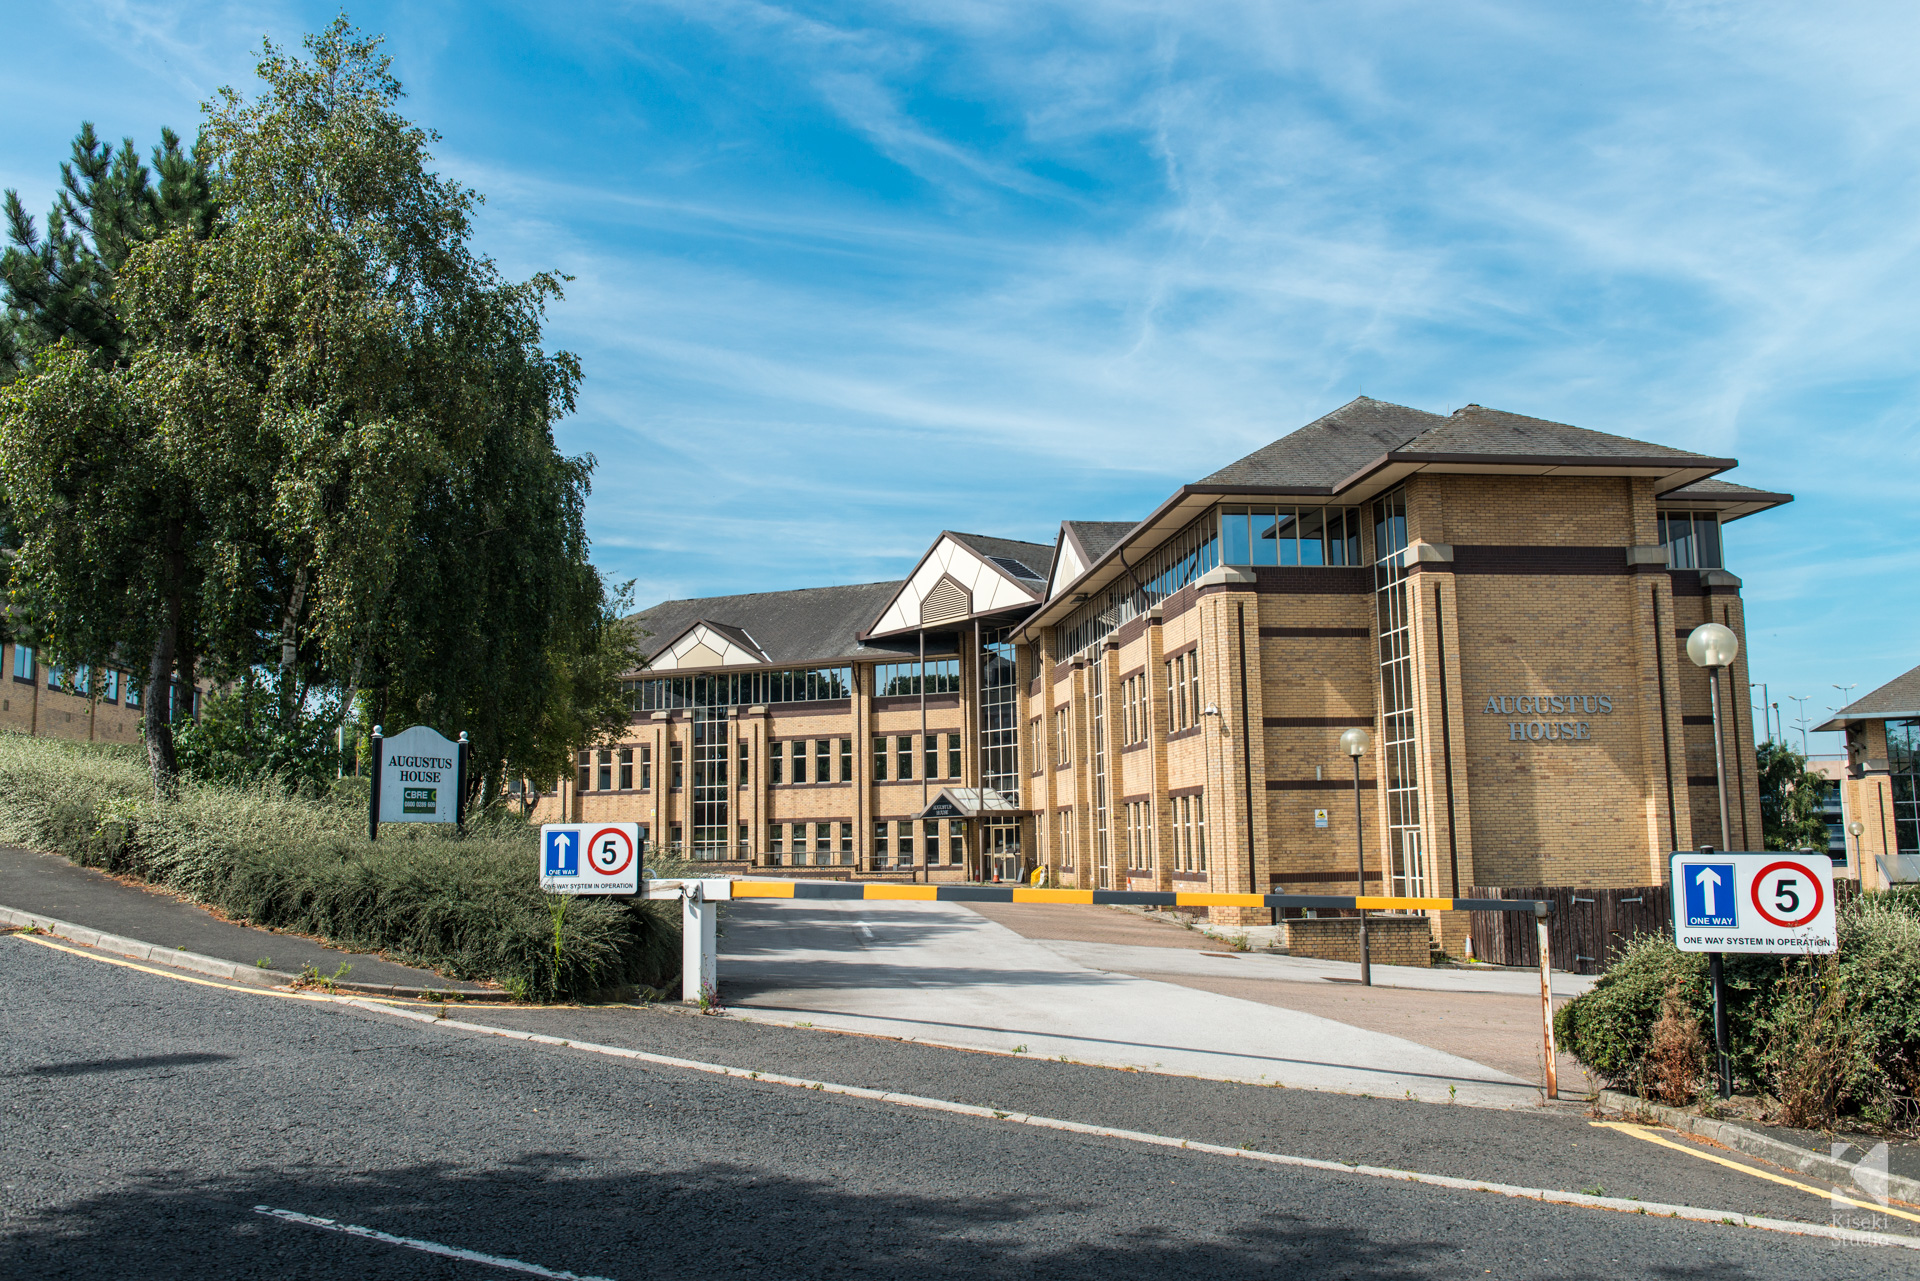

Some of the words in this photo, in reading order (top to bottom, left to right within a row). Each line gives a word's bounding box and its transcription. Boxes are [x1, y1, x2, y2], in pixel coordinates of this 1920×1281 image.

[1483, 695, 1613, 714] AUGUSTUS
[1508, 722, 1591, 741] HOUSE
[389, 755, 453, 769] AUGUSTUS
[400, 770, 441, 783] HOUSE
[404, 790, 429, 800] CBRE
[602, 840, 617, 865] 5
[1775, 879, 1800, 913] 5
[1690, 917, 1710, 925] ONE
[1712, 917, 1733, 926] WAY
[1683, 936, 1703, 945] ONE
[1704, 936, 1725, 945] WAY
[1726, 937, 1763, 946] SYSTEM
[1765, 938, 1775, 946] IN
[1776, 938, 1831, 948] OPERATION
